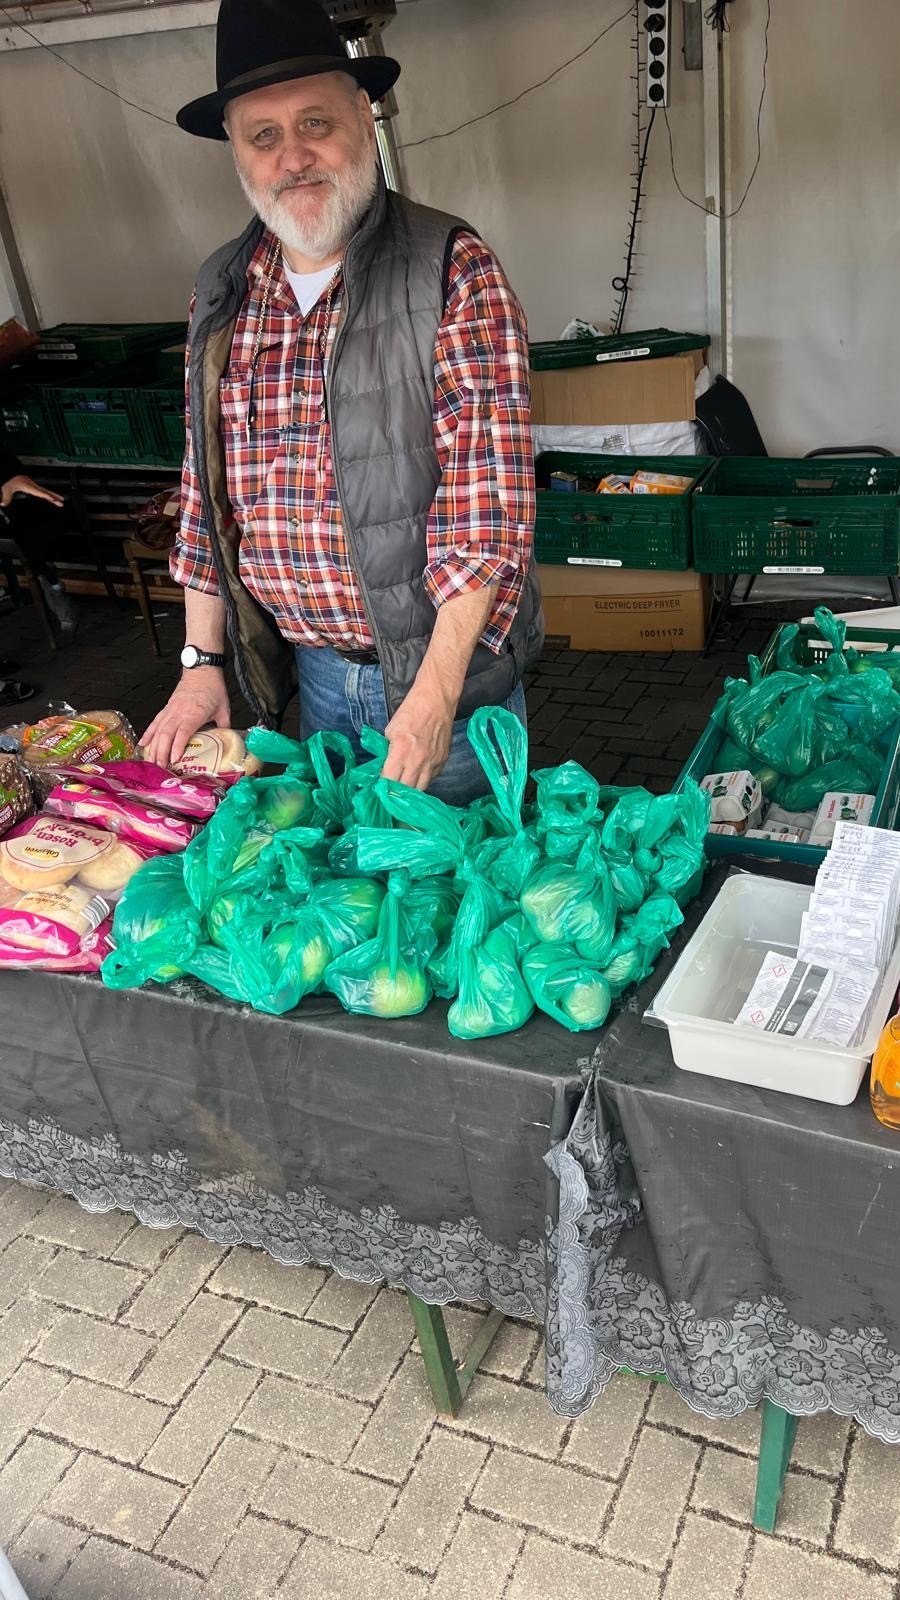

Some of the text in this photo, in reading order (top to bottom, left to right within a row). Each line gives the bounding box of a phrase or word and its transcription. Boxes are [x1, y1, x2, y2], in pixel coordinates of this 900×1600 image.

[595, 600, 680, 609] ELECTRIC DEEP FRYER
[640, 628, 684, 637] 10011172
